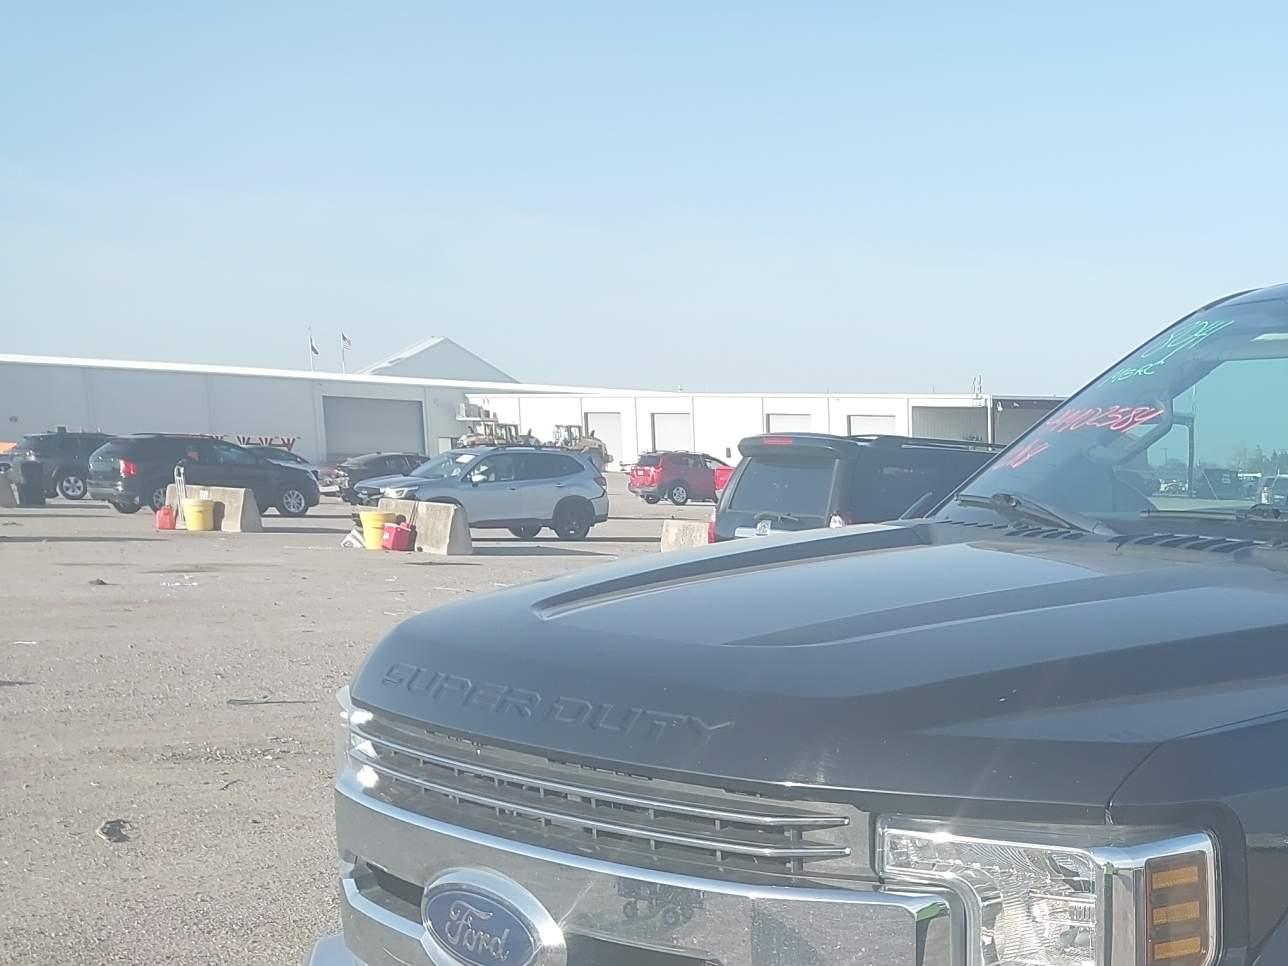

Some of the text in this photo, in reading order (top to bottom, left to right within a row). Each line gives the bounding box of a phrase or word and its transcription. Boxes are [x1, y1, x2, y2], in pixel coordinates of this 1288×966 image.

[381, 662, 736, 745] SUPER DUTY
[444, 900, 511, 962] Ford
